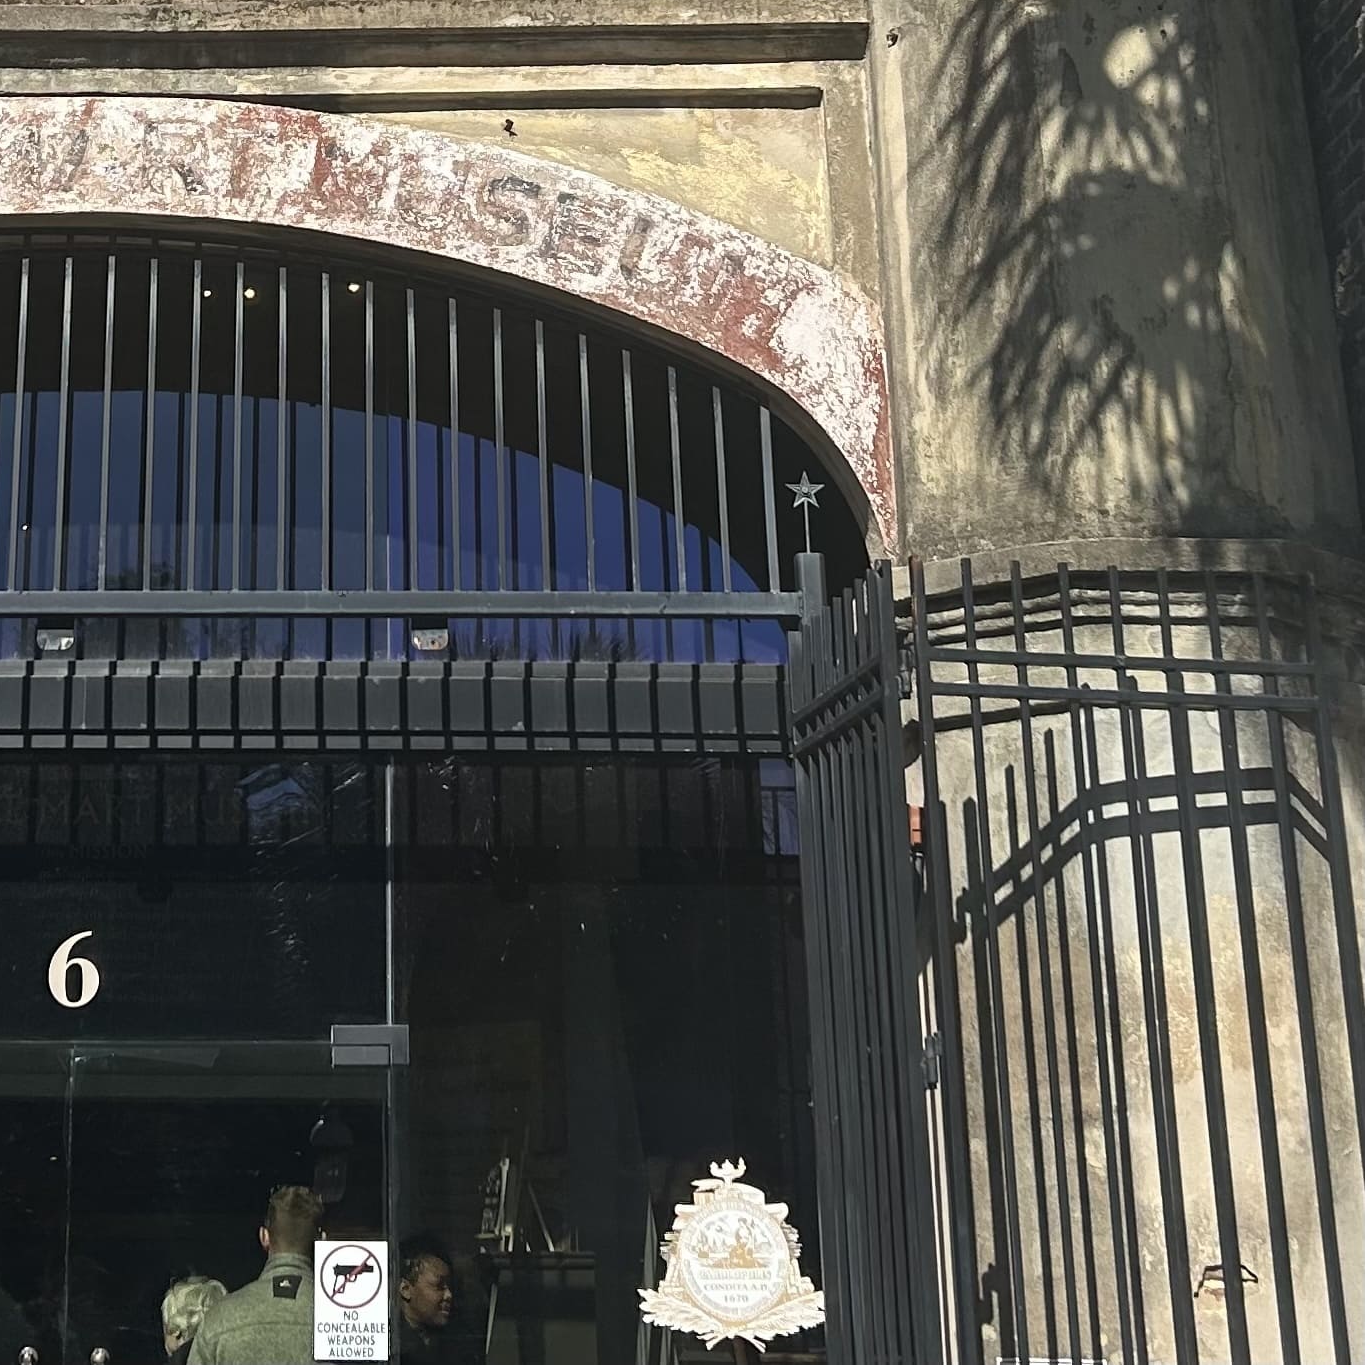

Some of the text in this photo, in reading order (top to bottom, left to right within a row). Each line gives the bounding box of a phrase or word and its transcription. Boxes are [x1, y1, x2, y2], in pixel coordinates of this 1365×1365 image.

[48, 930, 100, 1008] 6
[724, 1294, 749, 1303] 1670
[343, 1310, 359, 1321] NO
[317, 1322, 386, 1334] CONCEALABLE
[327, 1335, 376, 1346] WEAPONS
[329, 1347, 374, 1358] ALLOWED
